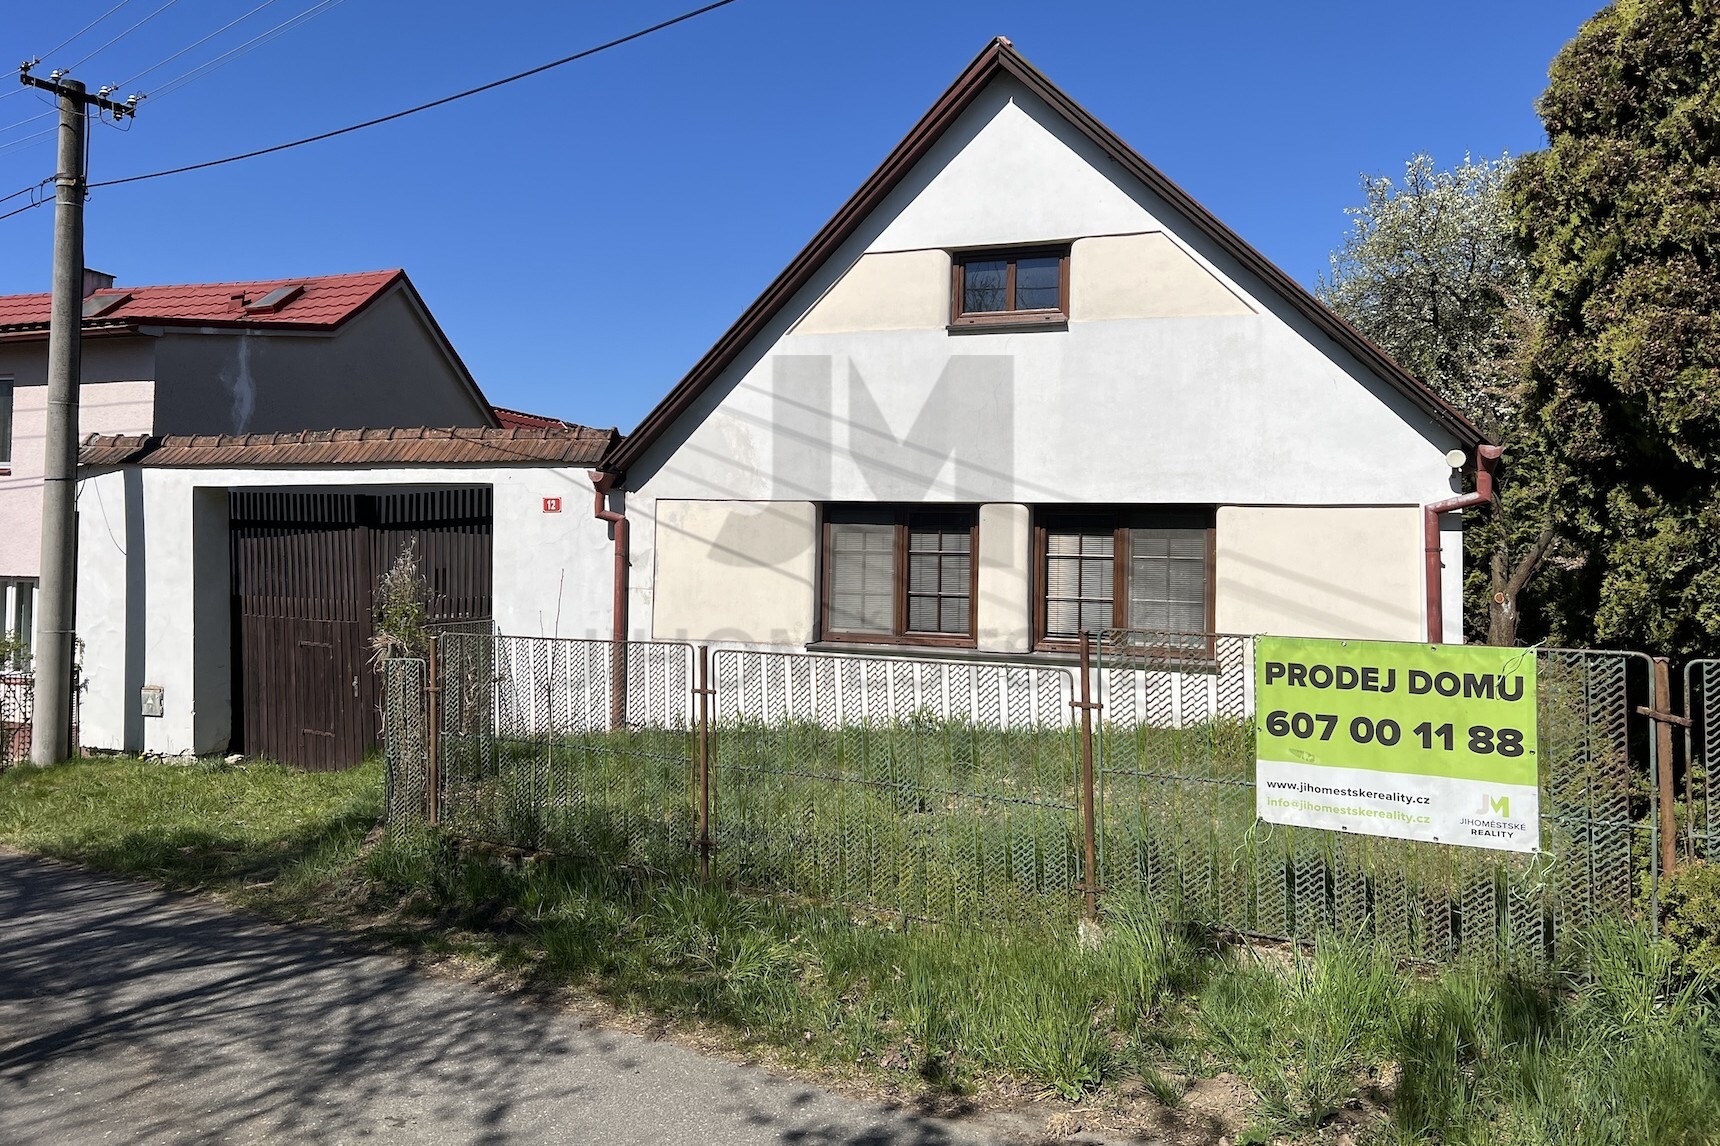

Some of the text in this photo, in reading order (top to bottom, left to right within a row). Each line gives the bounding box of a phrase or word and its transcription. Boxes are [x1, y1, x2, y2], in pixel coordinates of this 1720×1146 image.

[547, 499, 556, 511] 12
[1265, 662, 1524, 702] PRODEJ DOMU
[1265, 710, 1525, 758] 607 00 11 88
[1266, 780, 1431, 805] www.jihomestskereality.cz
[1266, 797, 1431, 824] info@jihomestskereality.cz
[1475, 794, 1510, 818] JM
[1471, 829, 1513, 839] REALITY
